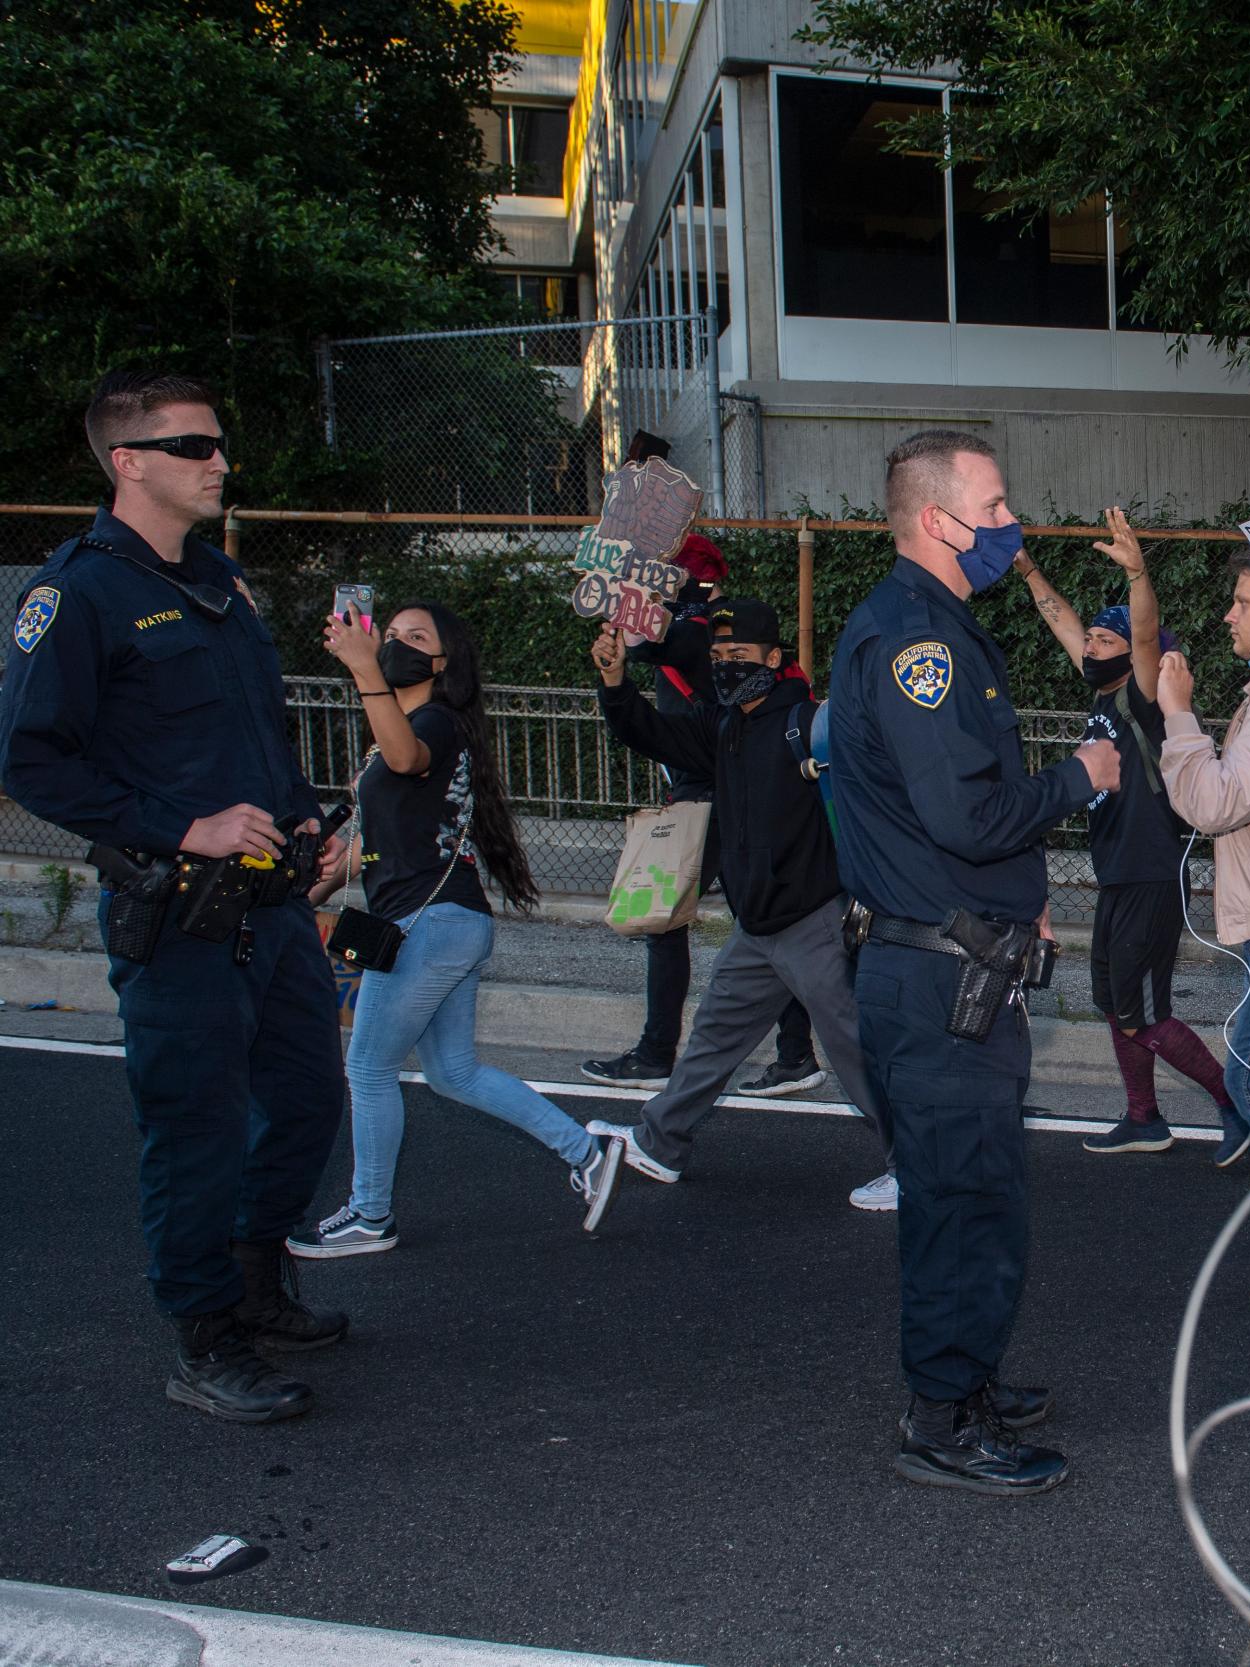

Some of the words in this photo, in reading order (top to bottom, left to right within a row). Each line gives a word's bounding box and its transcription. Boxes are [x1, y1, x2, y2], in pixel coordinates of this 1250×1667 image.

[134, 609, 183, 630] WATKINS
[897, 653, 922, 676] HIGHWAY
[923, 651, 948, 662] PATROL
[898, 644, 943, 666] CALIFORNIA
